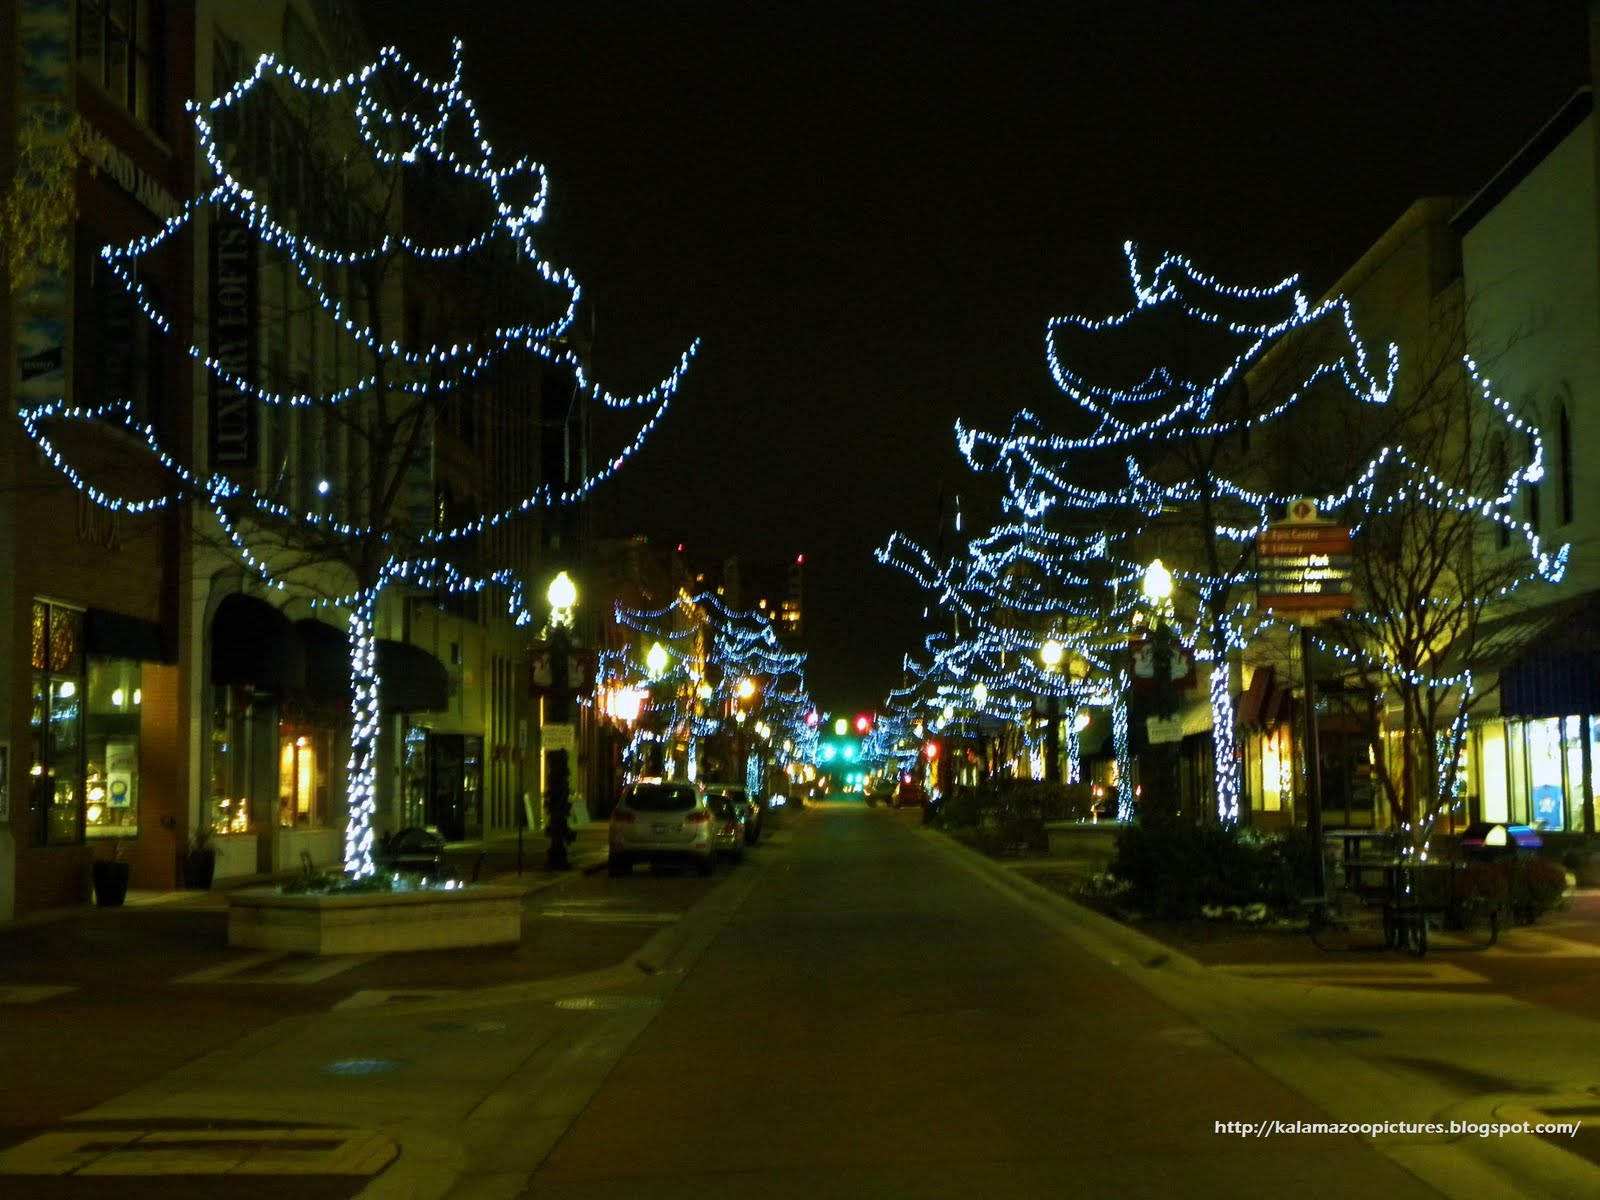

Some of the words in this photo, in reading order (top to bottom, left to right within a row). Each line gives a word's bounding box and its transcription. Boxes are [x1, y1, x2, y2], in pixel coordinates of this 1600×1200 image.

[217, 227, 249, 329] LOFTS
[1292, 528, 1319, 539] Center
[1273, 543, 1303, 555] Library
[1273, 556, 1308, 567] Bronson
[1309, 554, 1329, 567] Park
[1274, 569, 1304, 582] County
[1275, 582, 1303, 593] Visitor
[1304, 580, 1322, 593] Info
